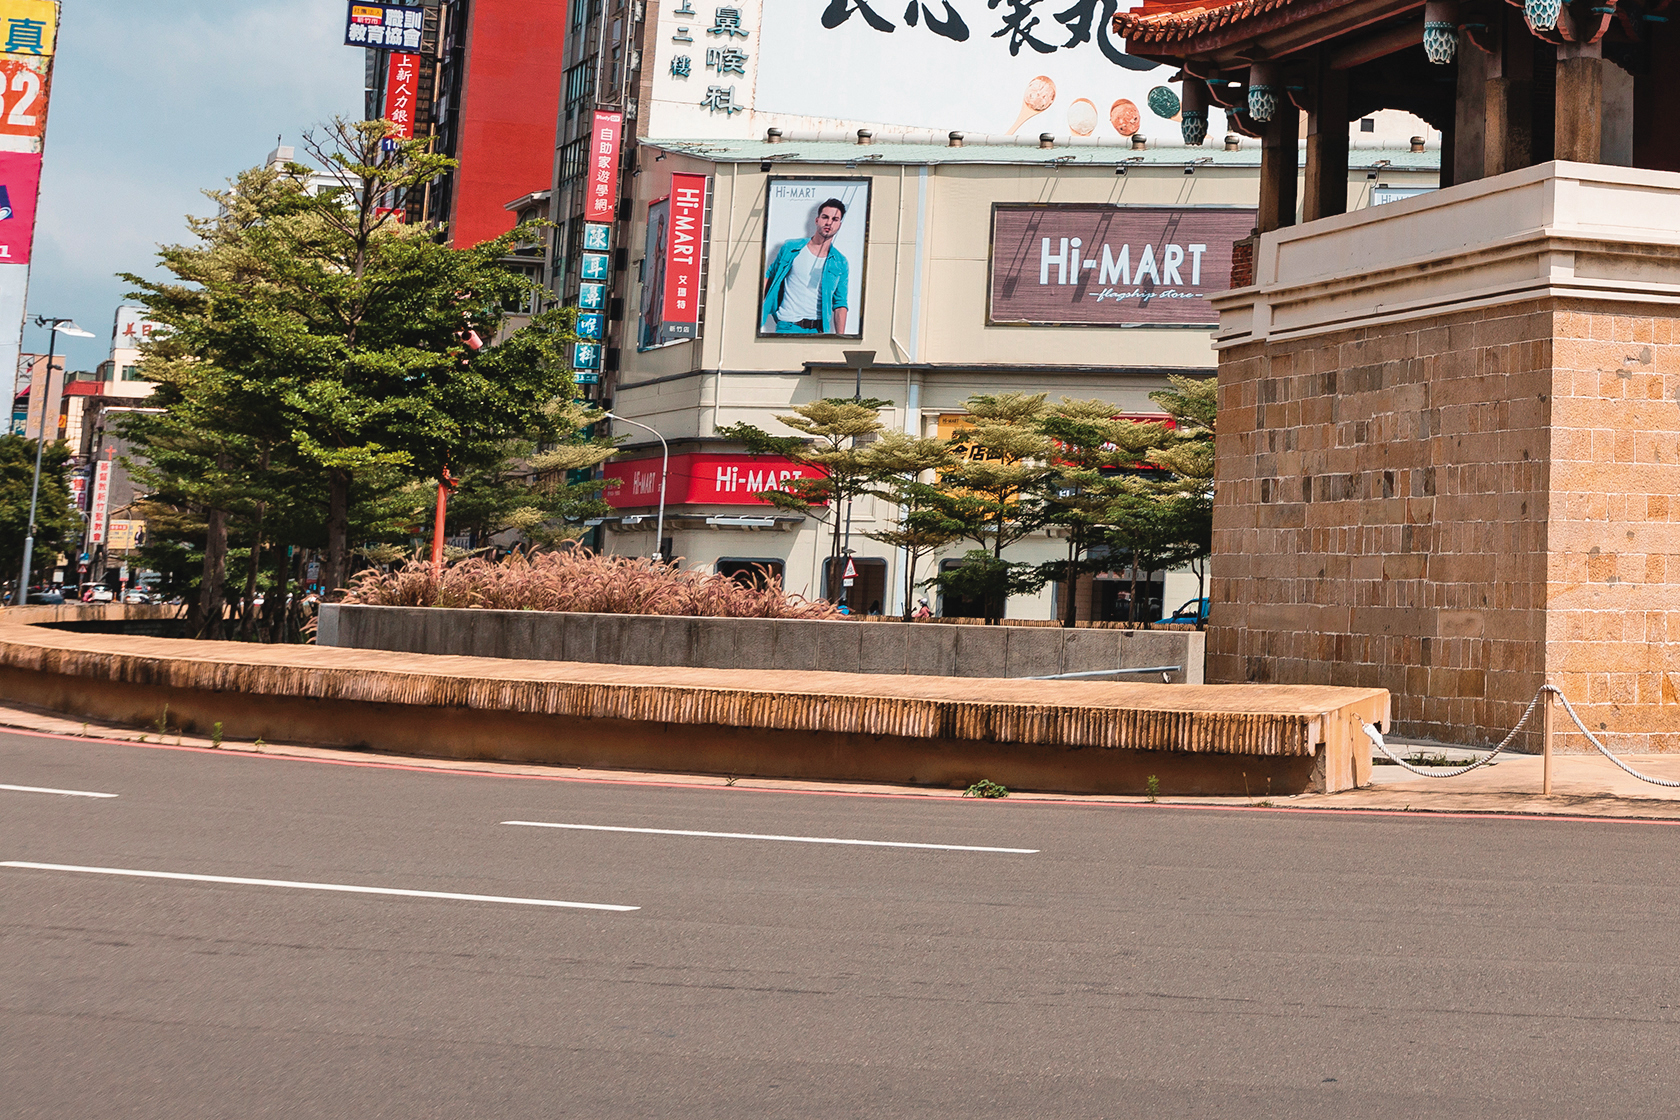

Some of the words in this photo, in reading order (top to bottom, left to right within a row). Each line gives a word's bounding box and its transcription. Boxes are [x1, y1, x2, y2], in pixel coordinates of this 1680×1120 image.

[348, 23, 421, 47] 教育協會
[390, 55, 413, 137] 上新人力銀行
[594, 128, 613, 211] 自助家遊學網
[776, 186, 816, 198] Hi-MART
[673, 188, 700, 265] Hi-MART
[1039, 237, 1207, 285] Hi-MART
[579, 227, 608, 367] 陳耳鼻喉科
[669, 325, 690, 333] 新竹店
[716, 466, 802, 492] Hi-MART
